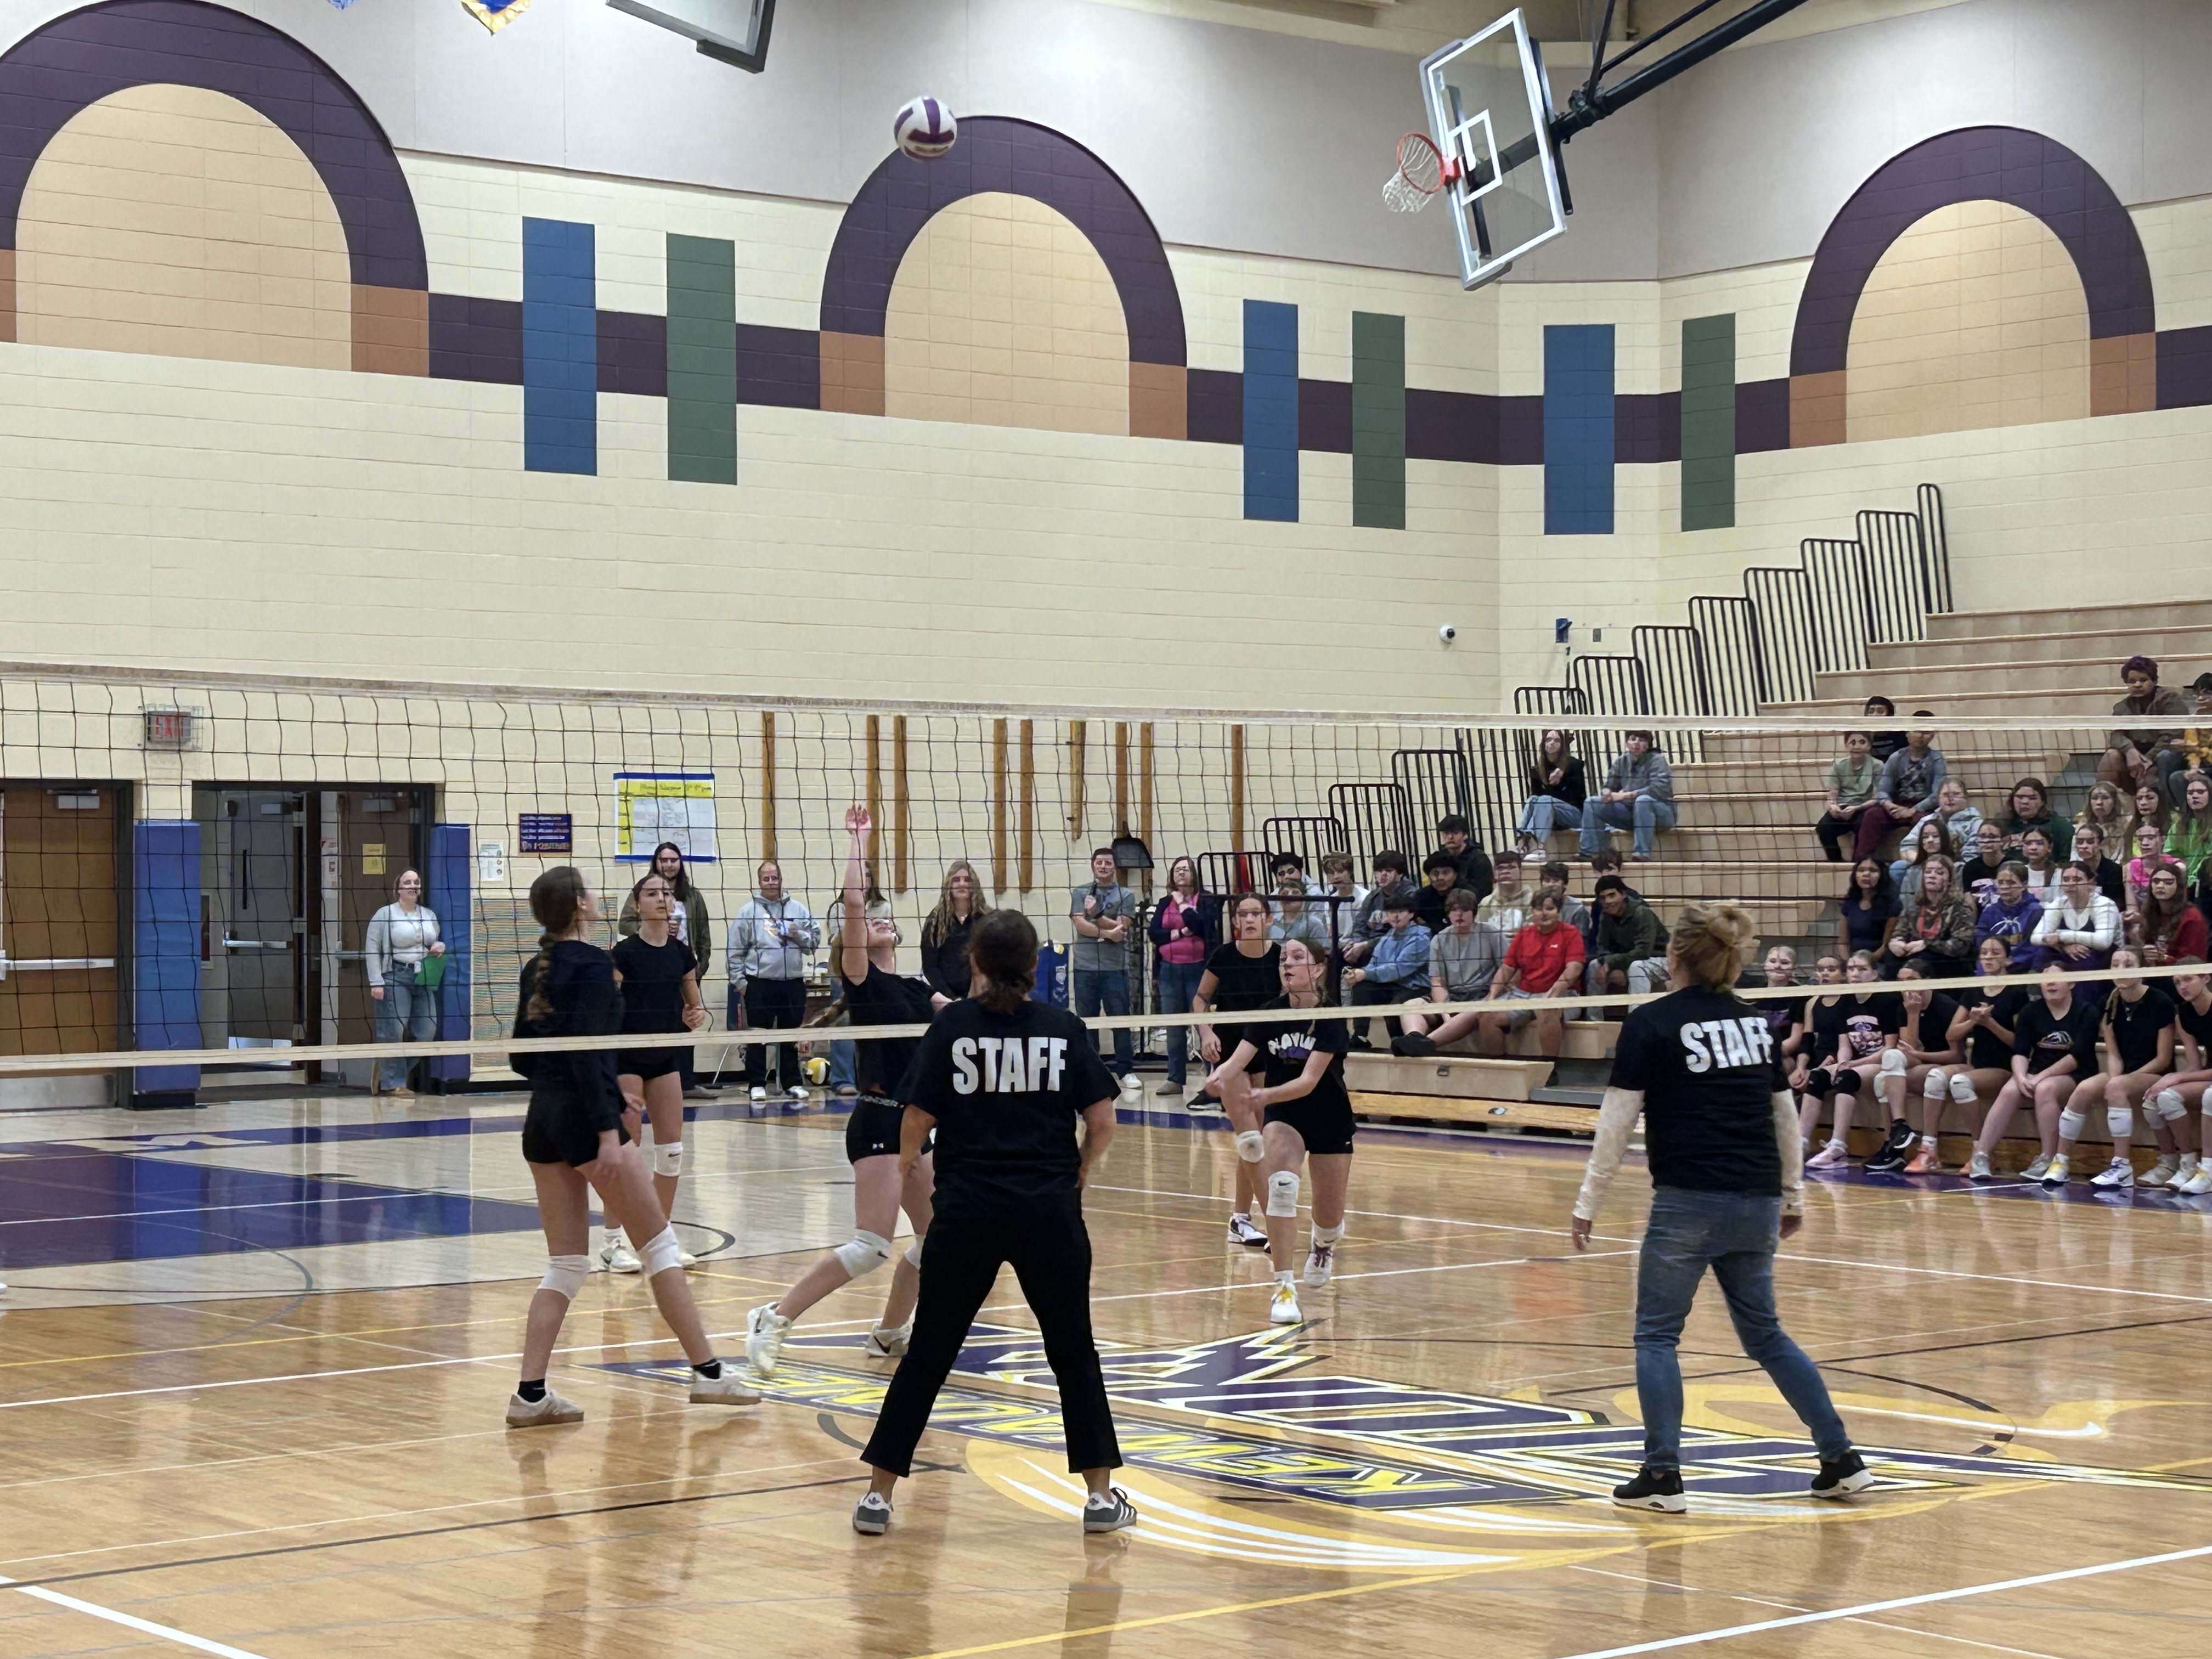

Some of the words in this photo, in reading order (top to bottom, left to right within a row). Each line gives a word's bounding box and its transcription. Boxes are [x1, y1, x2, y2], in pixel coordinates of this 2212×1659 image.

[156, 715, 185, 737] EXIT
[952, 1037, 1068, 1094] STAFF
[1680, 1017, 1774, 1073] STAFF
